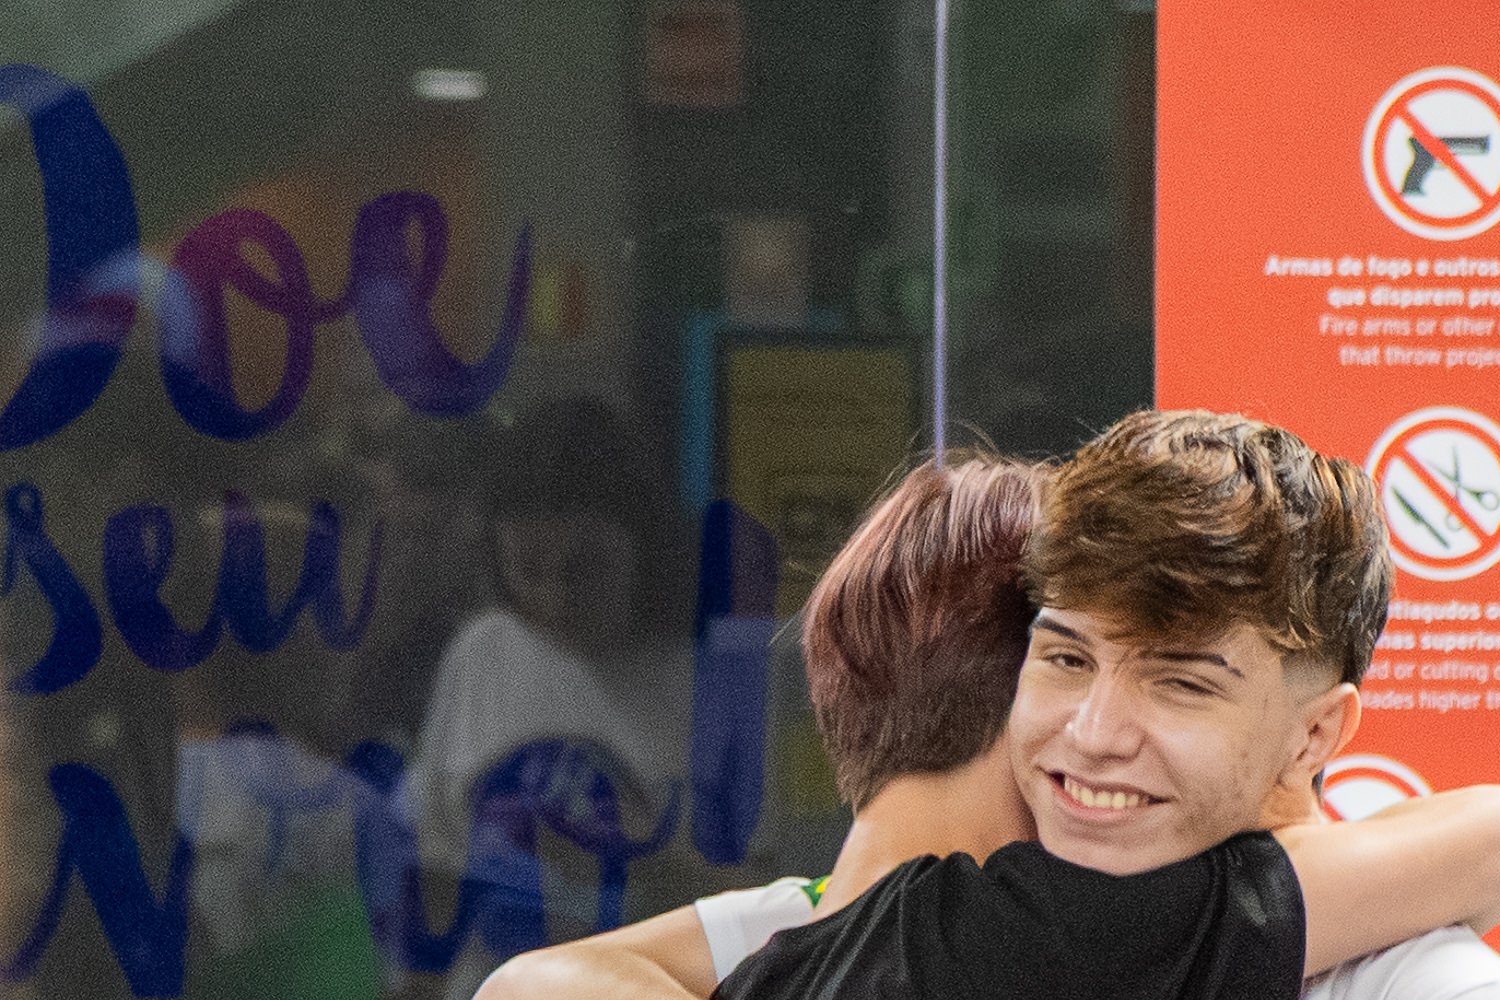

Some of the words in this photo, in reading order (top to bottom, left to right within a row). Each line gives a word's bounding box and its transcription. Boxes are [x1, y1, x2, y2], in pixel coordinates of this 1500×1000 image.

[1264, 255, 1333, 277] Armas
[1337, 255, 1363, 277] de
[1367, 256, 1412, 279] fogo
[1416, 260, 1430, 277] e
[1433, 256, 1500, 277] outros
[1328, 288, 1366, 308] que
[1370, 287, 1466, 308] disparem
[1319, 315, 1358, 337] Fire
[1362, 319, 1411, 337] arms
[1416, 319, 1437, 337] or
[1441, 316, 1495, 337] other
[1339, 346, 1380, 367] that
[1384, 346, 1442, 367] throw
[1388, 601, 1481, 624] tiagudos
[1394, 663, 1415, 680] or
[1421, 660, 1487, 684] cutting
[1419, 690, 1480, 713] higher
